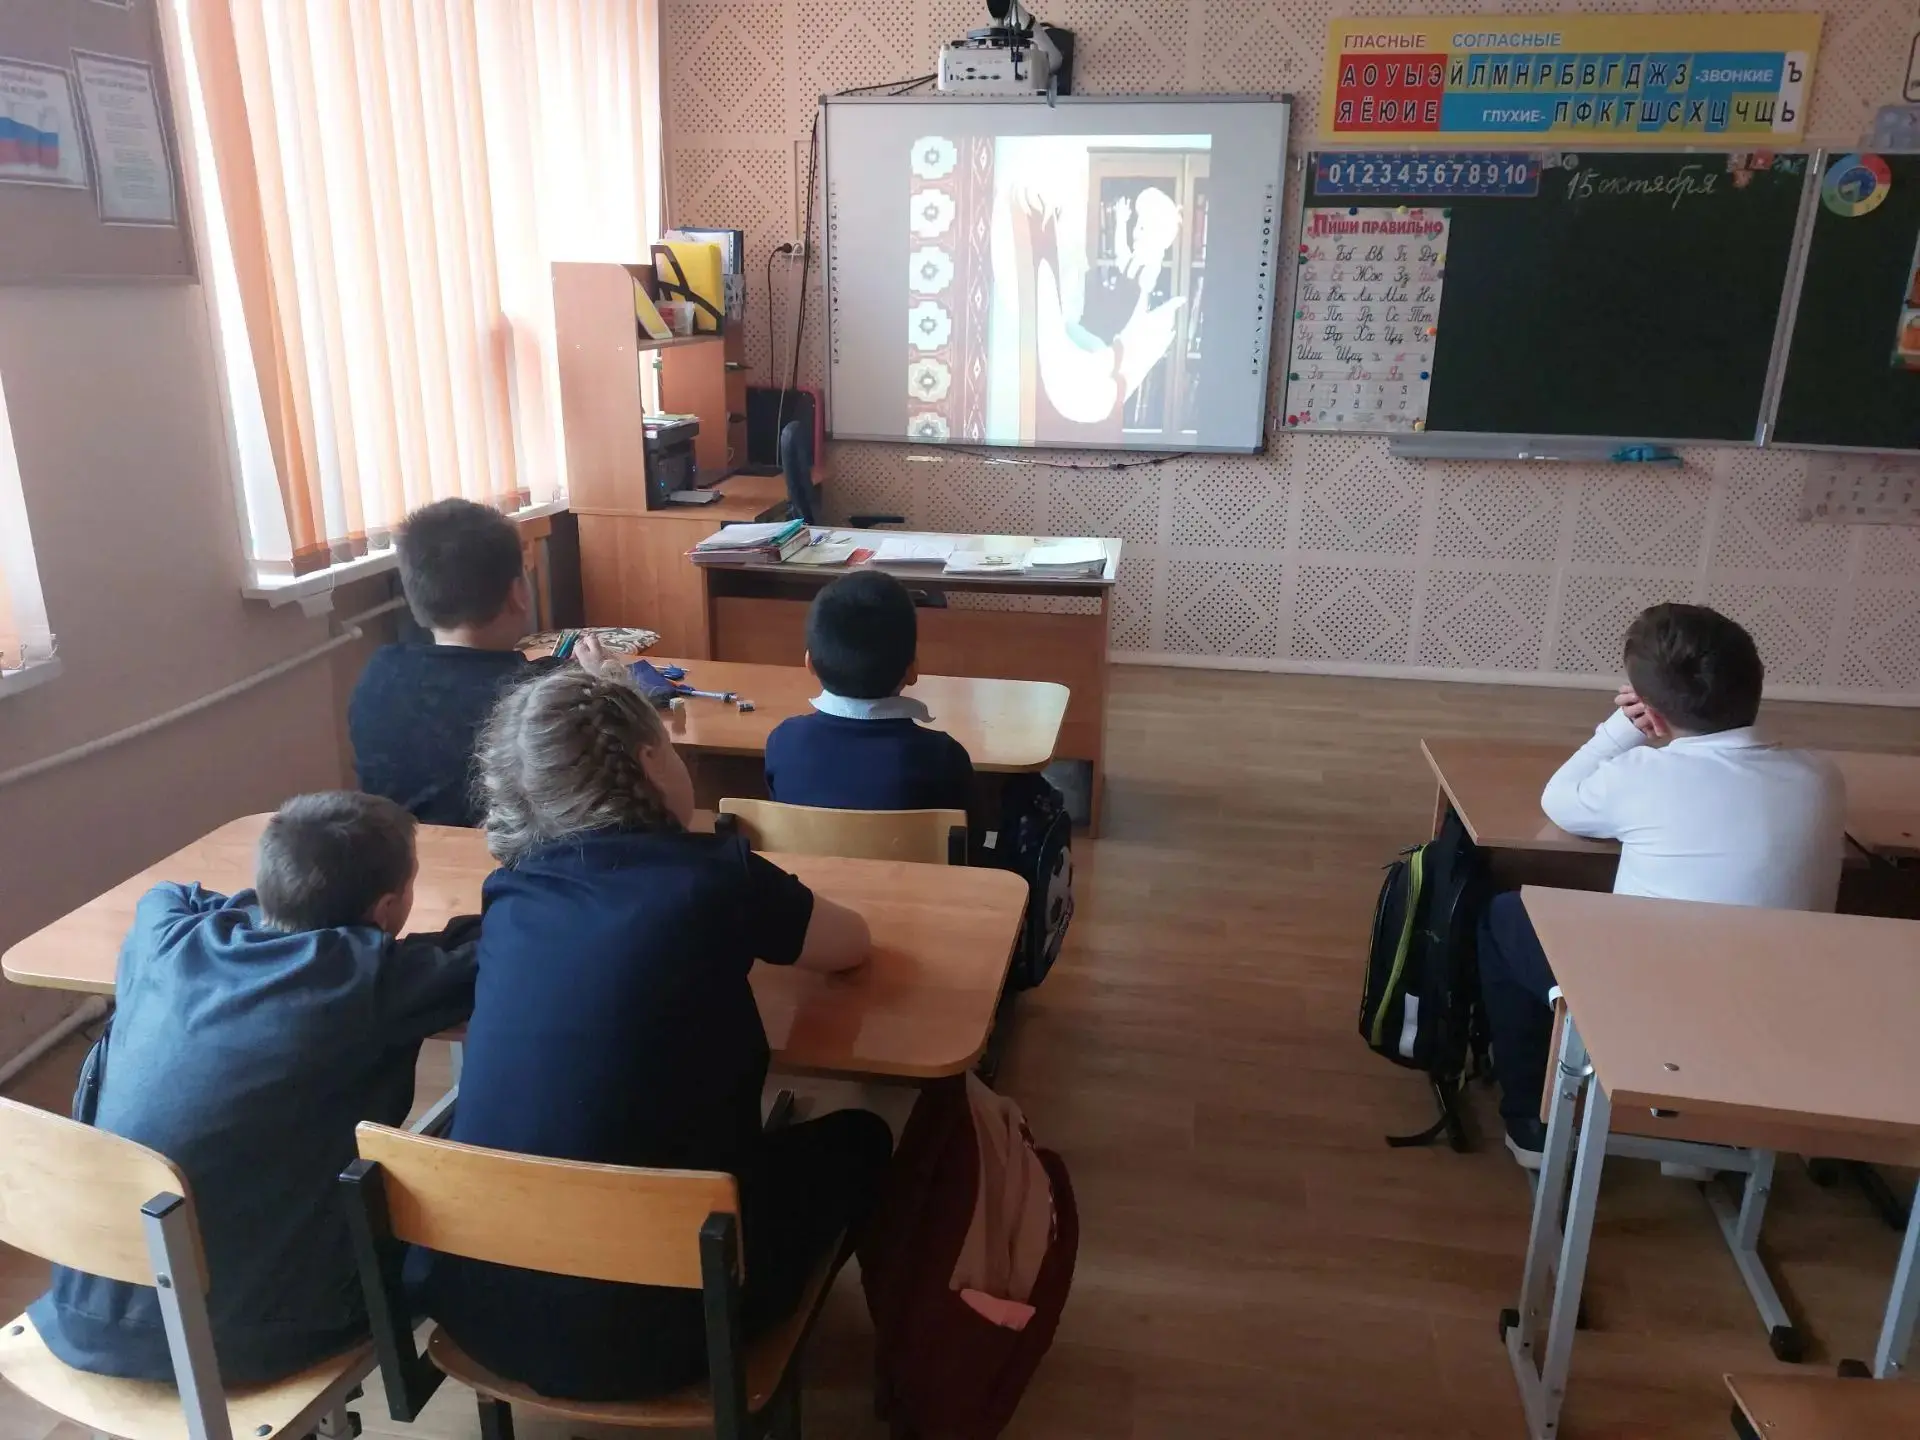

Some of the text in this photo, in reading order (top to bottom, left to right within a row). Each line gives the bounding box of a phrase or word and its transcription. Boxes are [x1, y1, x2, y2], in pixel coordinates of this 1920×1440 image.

[1343, 34, 1427, 48] ГЛАСНЫЕ
[1452, 32, 1563, 48] СОГЛАСНЫЕ
[1788, 61, 1802, 83] Ъ
[1781, 101, 1795, 122] Ь
[1329, 163, 1527, 185] 0 1 2 3 4 5 6 7 8 9 10
[1567, 164, 1718, 209] 15 октября
